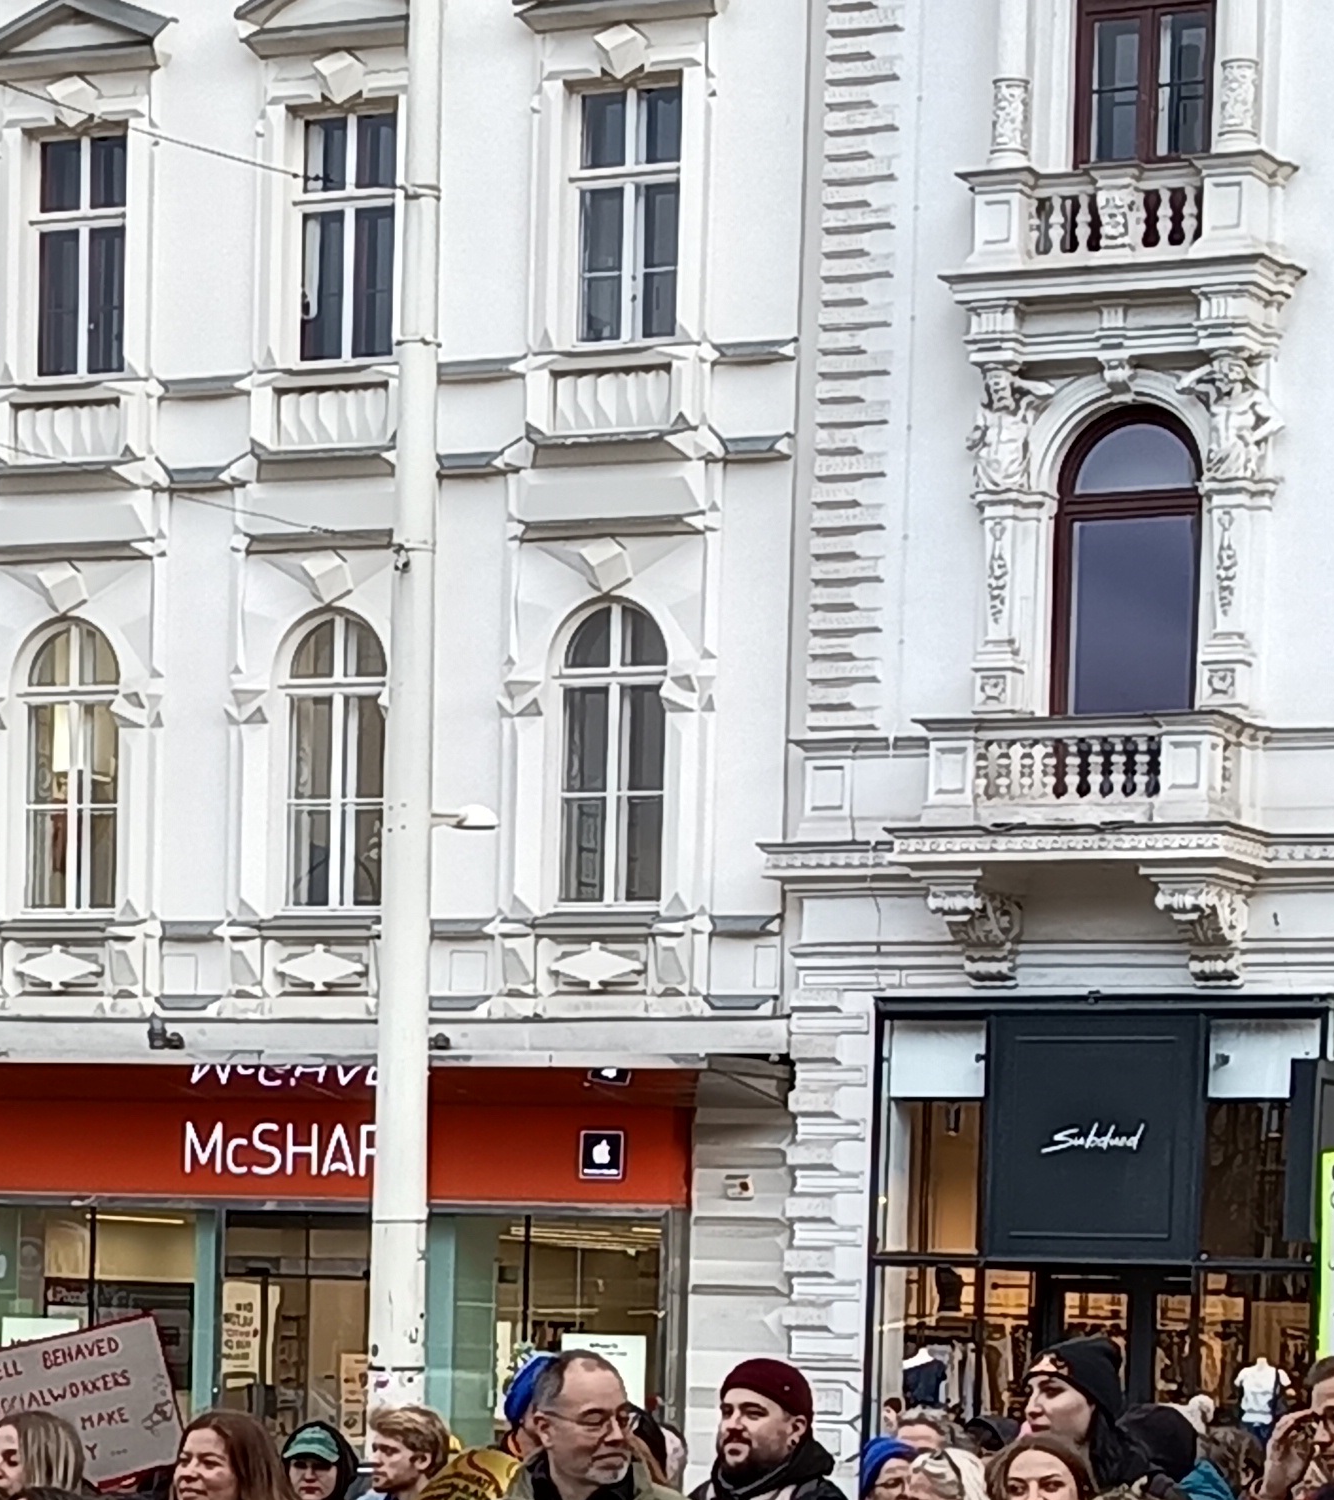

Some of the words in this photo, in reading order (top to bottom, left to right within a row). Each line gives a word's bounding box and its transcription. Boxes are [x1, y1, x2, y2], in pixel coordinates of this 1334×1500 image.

[1041, 1122, 1145, 1154] Subdued
[42, 1336, 120, 1370] BEHAVED
[80, 1406, 130, 1431] MAKE
